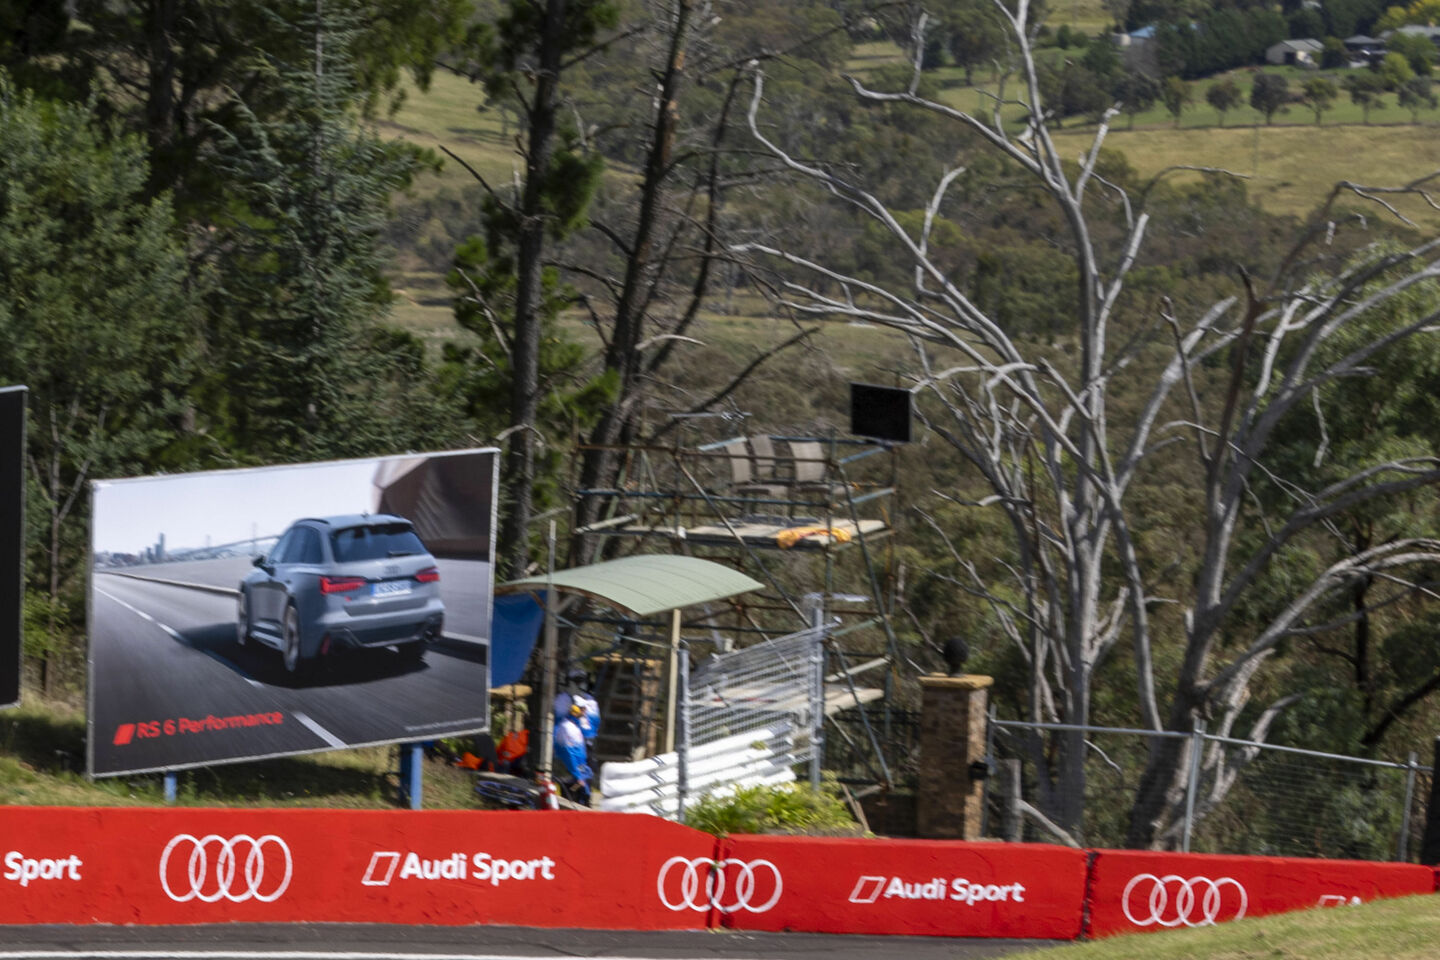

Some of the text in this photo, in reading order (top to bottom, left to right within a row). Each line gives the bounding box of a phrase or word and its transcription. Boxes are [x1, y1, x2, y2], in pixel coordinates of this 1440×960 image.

[136, 711, 284, 739] RS 6 Performance
[3, 851, 83, 887] Sport
[399, 852, 556, 887] Audi Sport
[883, 876, 1026, 906] Audi Sport
